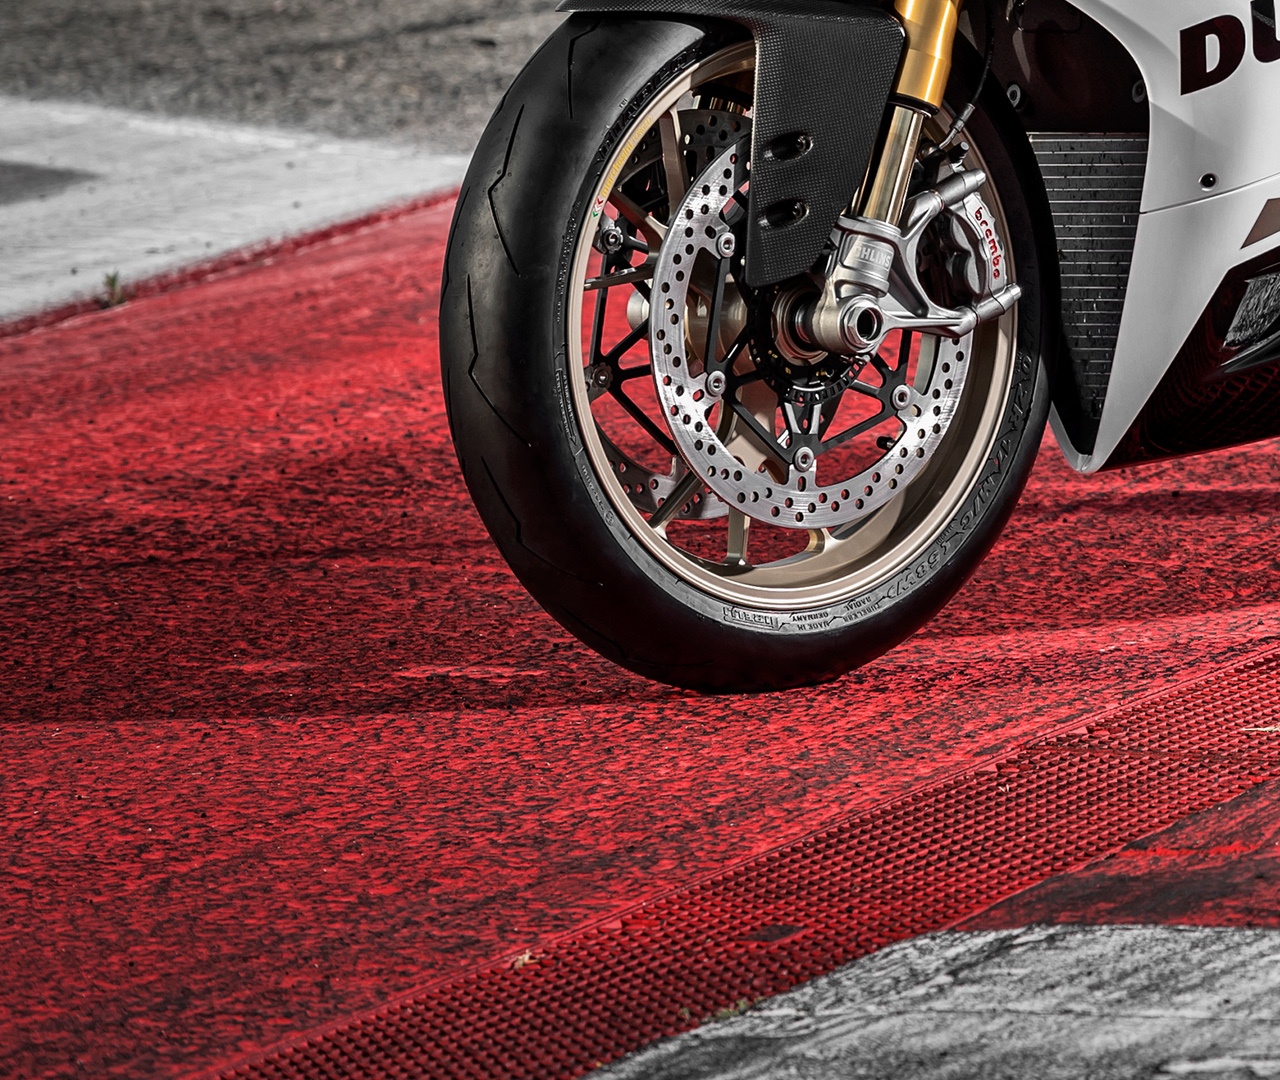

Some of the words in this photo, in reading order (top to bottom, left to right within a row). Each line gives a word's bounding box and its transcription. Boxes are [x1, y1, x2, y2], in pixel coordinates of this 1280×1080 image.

[974, 206, 1001, 280] brembo
[792, 611, 829, 623] GERMANY
[808, 620, 830, 631] MADE
